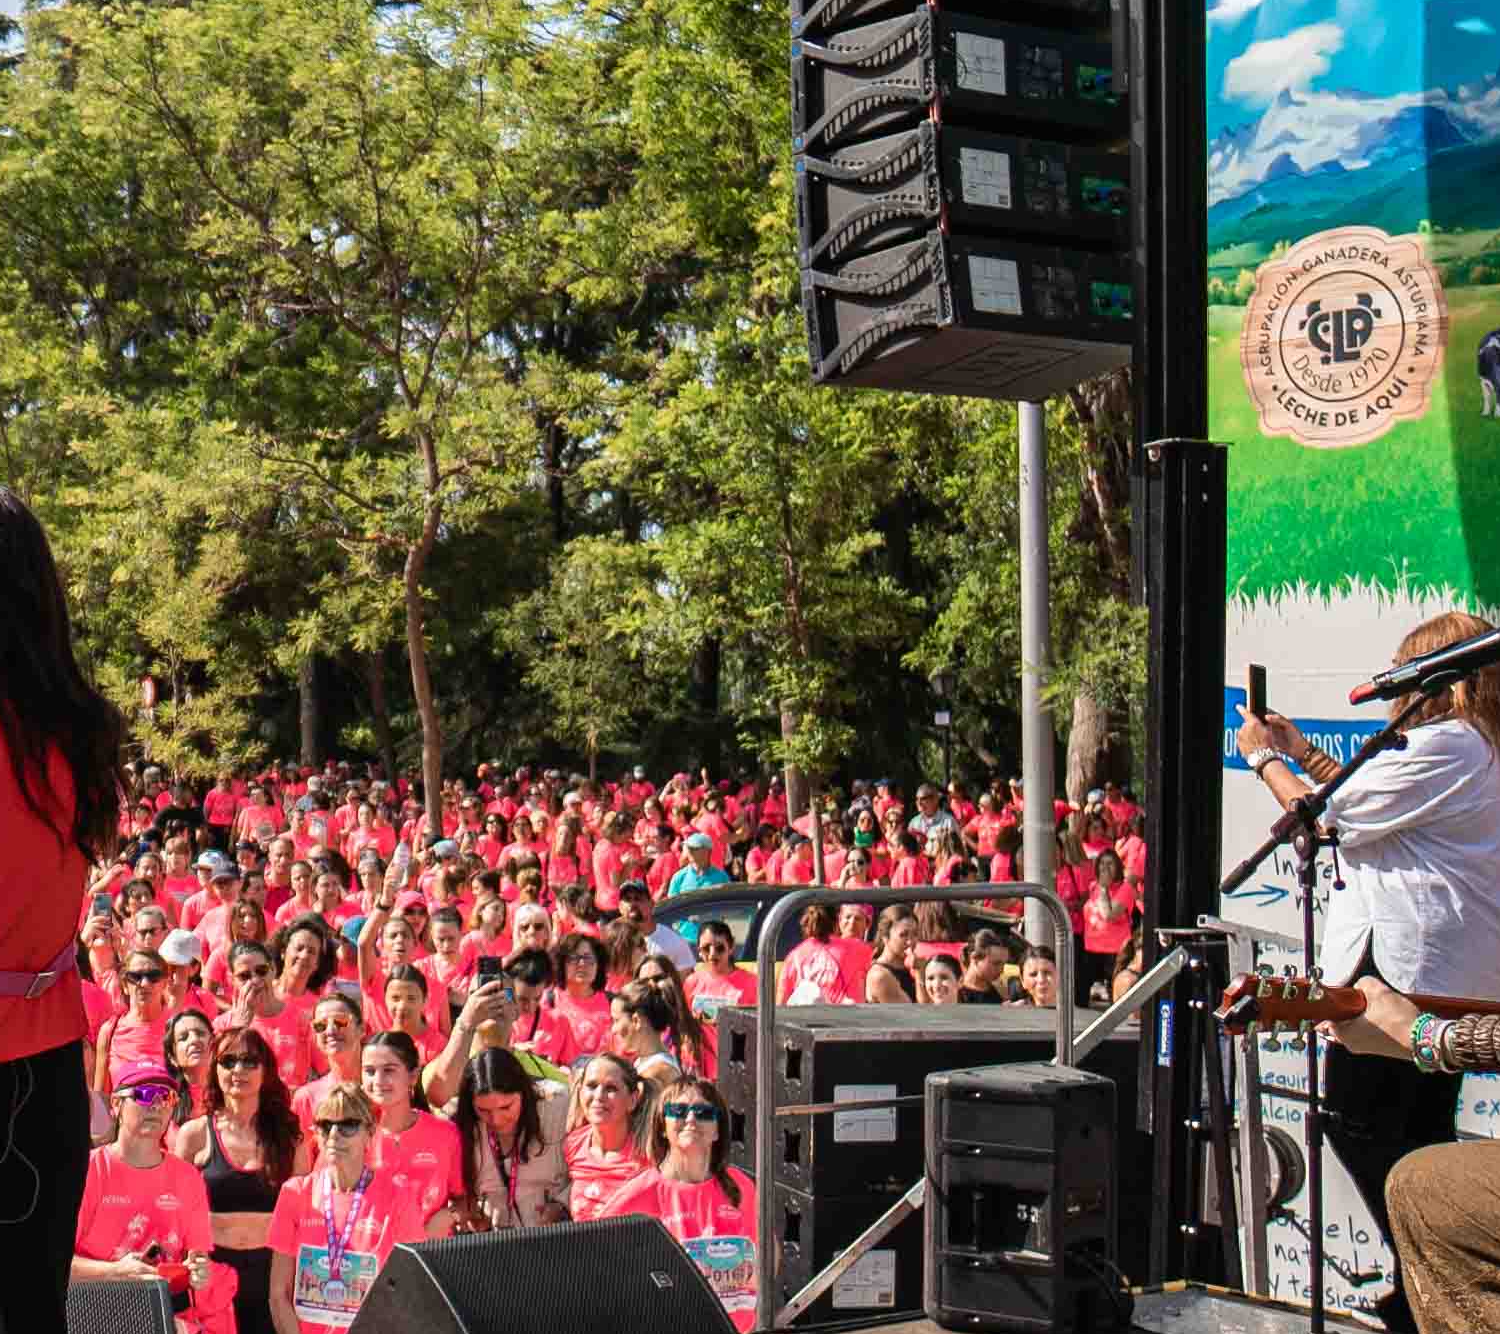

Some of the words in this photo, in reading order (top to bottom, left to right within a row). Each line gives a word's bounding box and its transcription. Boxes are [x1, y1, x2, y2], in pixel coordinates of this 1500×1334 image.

[1257, 273, 1299, 377] AGRUPACIÓN
[1301, 246, 1390, 275] GANADERA
[1391, 267, 1429, 357] ASTURIANA
[1292, 354, 1343, 394] Desde
[1346, 347, 1390, 389] 1970
[1274, 388, 1329, 427] LECHE
[1334, 412, 1360, 427] DE
[1365, 374, 1410, 419] AQUÍ
[1348, 1215, 1369, 1244] lo
